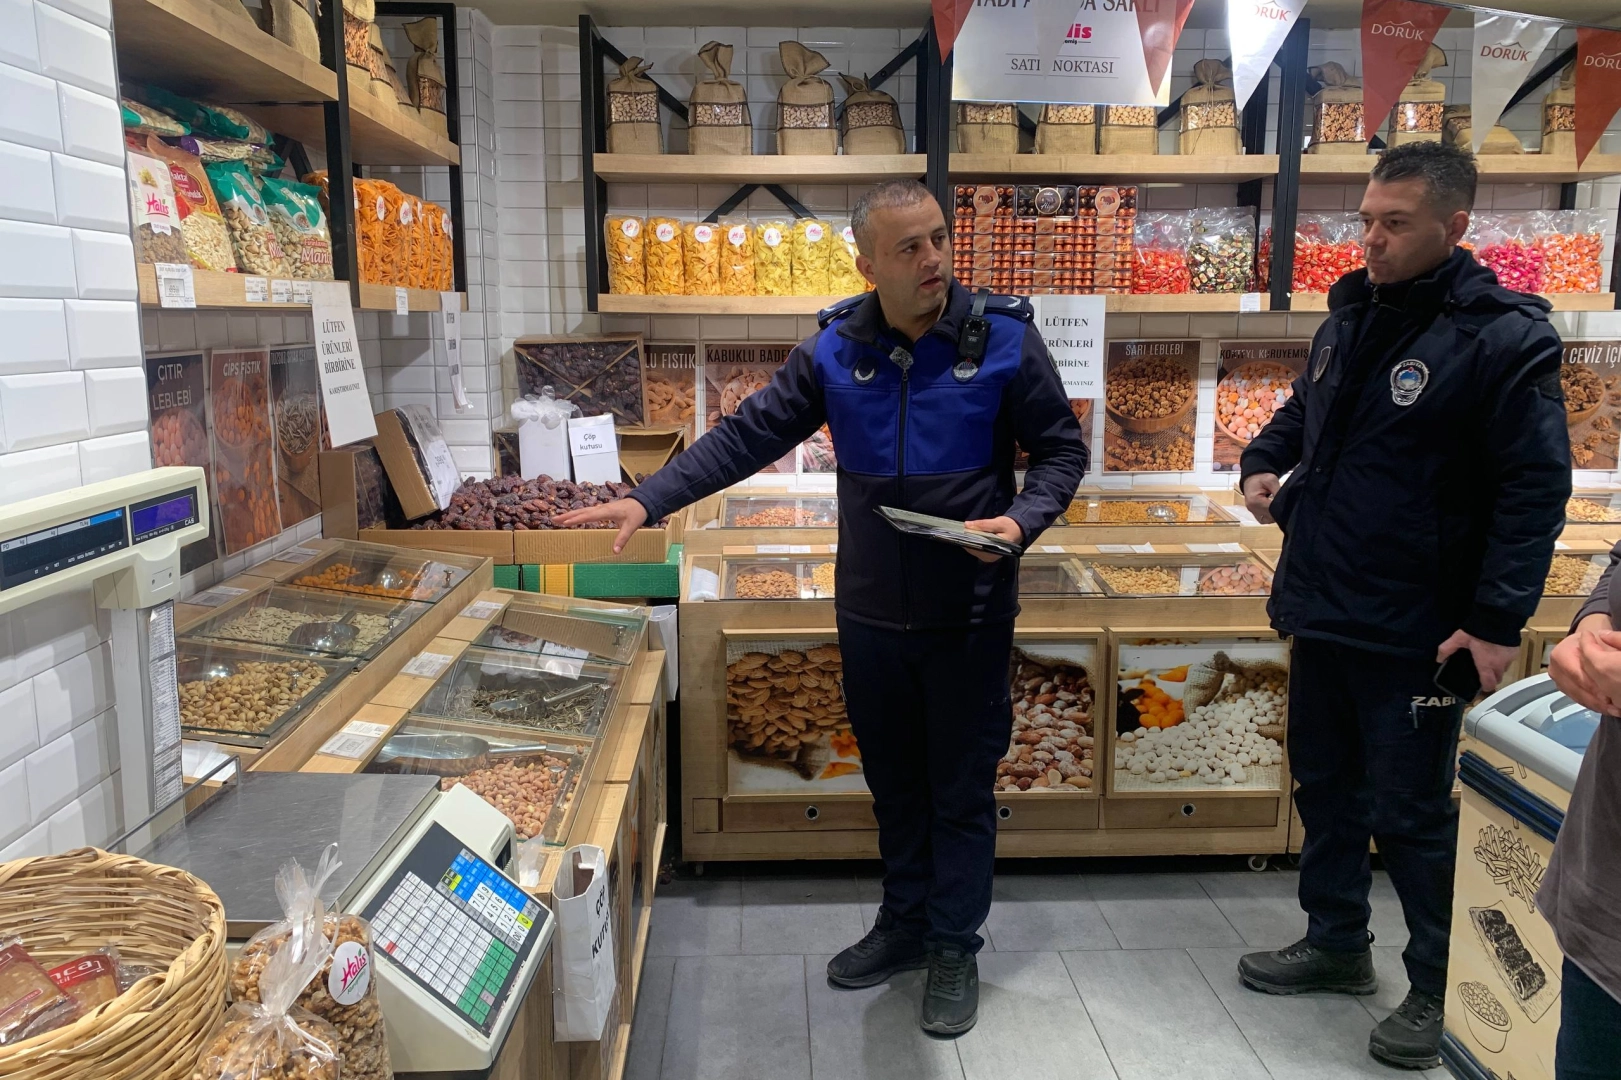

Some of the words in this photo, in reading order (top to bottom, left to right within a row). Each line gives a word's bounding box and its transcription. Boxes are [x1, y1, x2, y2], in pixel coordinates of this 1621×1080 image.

[1066, 24, 1092, 38] lis
[1371, 23, 1425, 41] DORUK
[1480, 45, 1531, 62] DORUK
[1010, 58, 1040, 71] SATI
[1052, 60, 1114, 74] NOKTASI
[1584, 55, 1621, 70] DORU
[146, 192, 170, 214] Halis
[322, 319, 346, 334] LÜTFEN
[1045, 316, 1088, 326] LÜTFEN
[322, 338, 352, 355] ÜRÜNLERİ
[1126, 344, 1146, 356] SARI
[1150, 342, 1184, 356] LEBLEBİ
[1570, 345, 1603, 364] CEVİZ
[662, 353, 696, 368] FISTIK
[707, 350, 755, 362] KABUKLU
[324, 357, 356, 374] BİRBİRİNE
[158, 363, 183, 386] ÇITIR
[152, 386, 192, 410] LEBLEBİ
[580, 442, 602, 450] kutusu
[584, 434, 596, 442] Çöp
[341, 954, 366, 990] Halis
